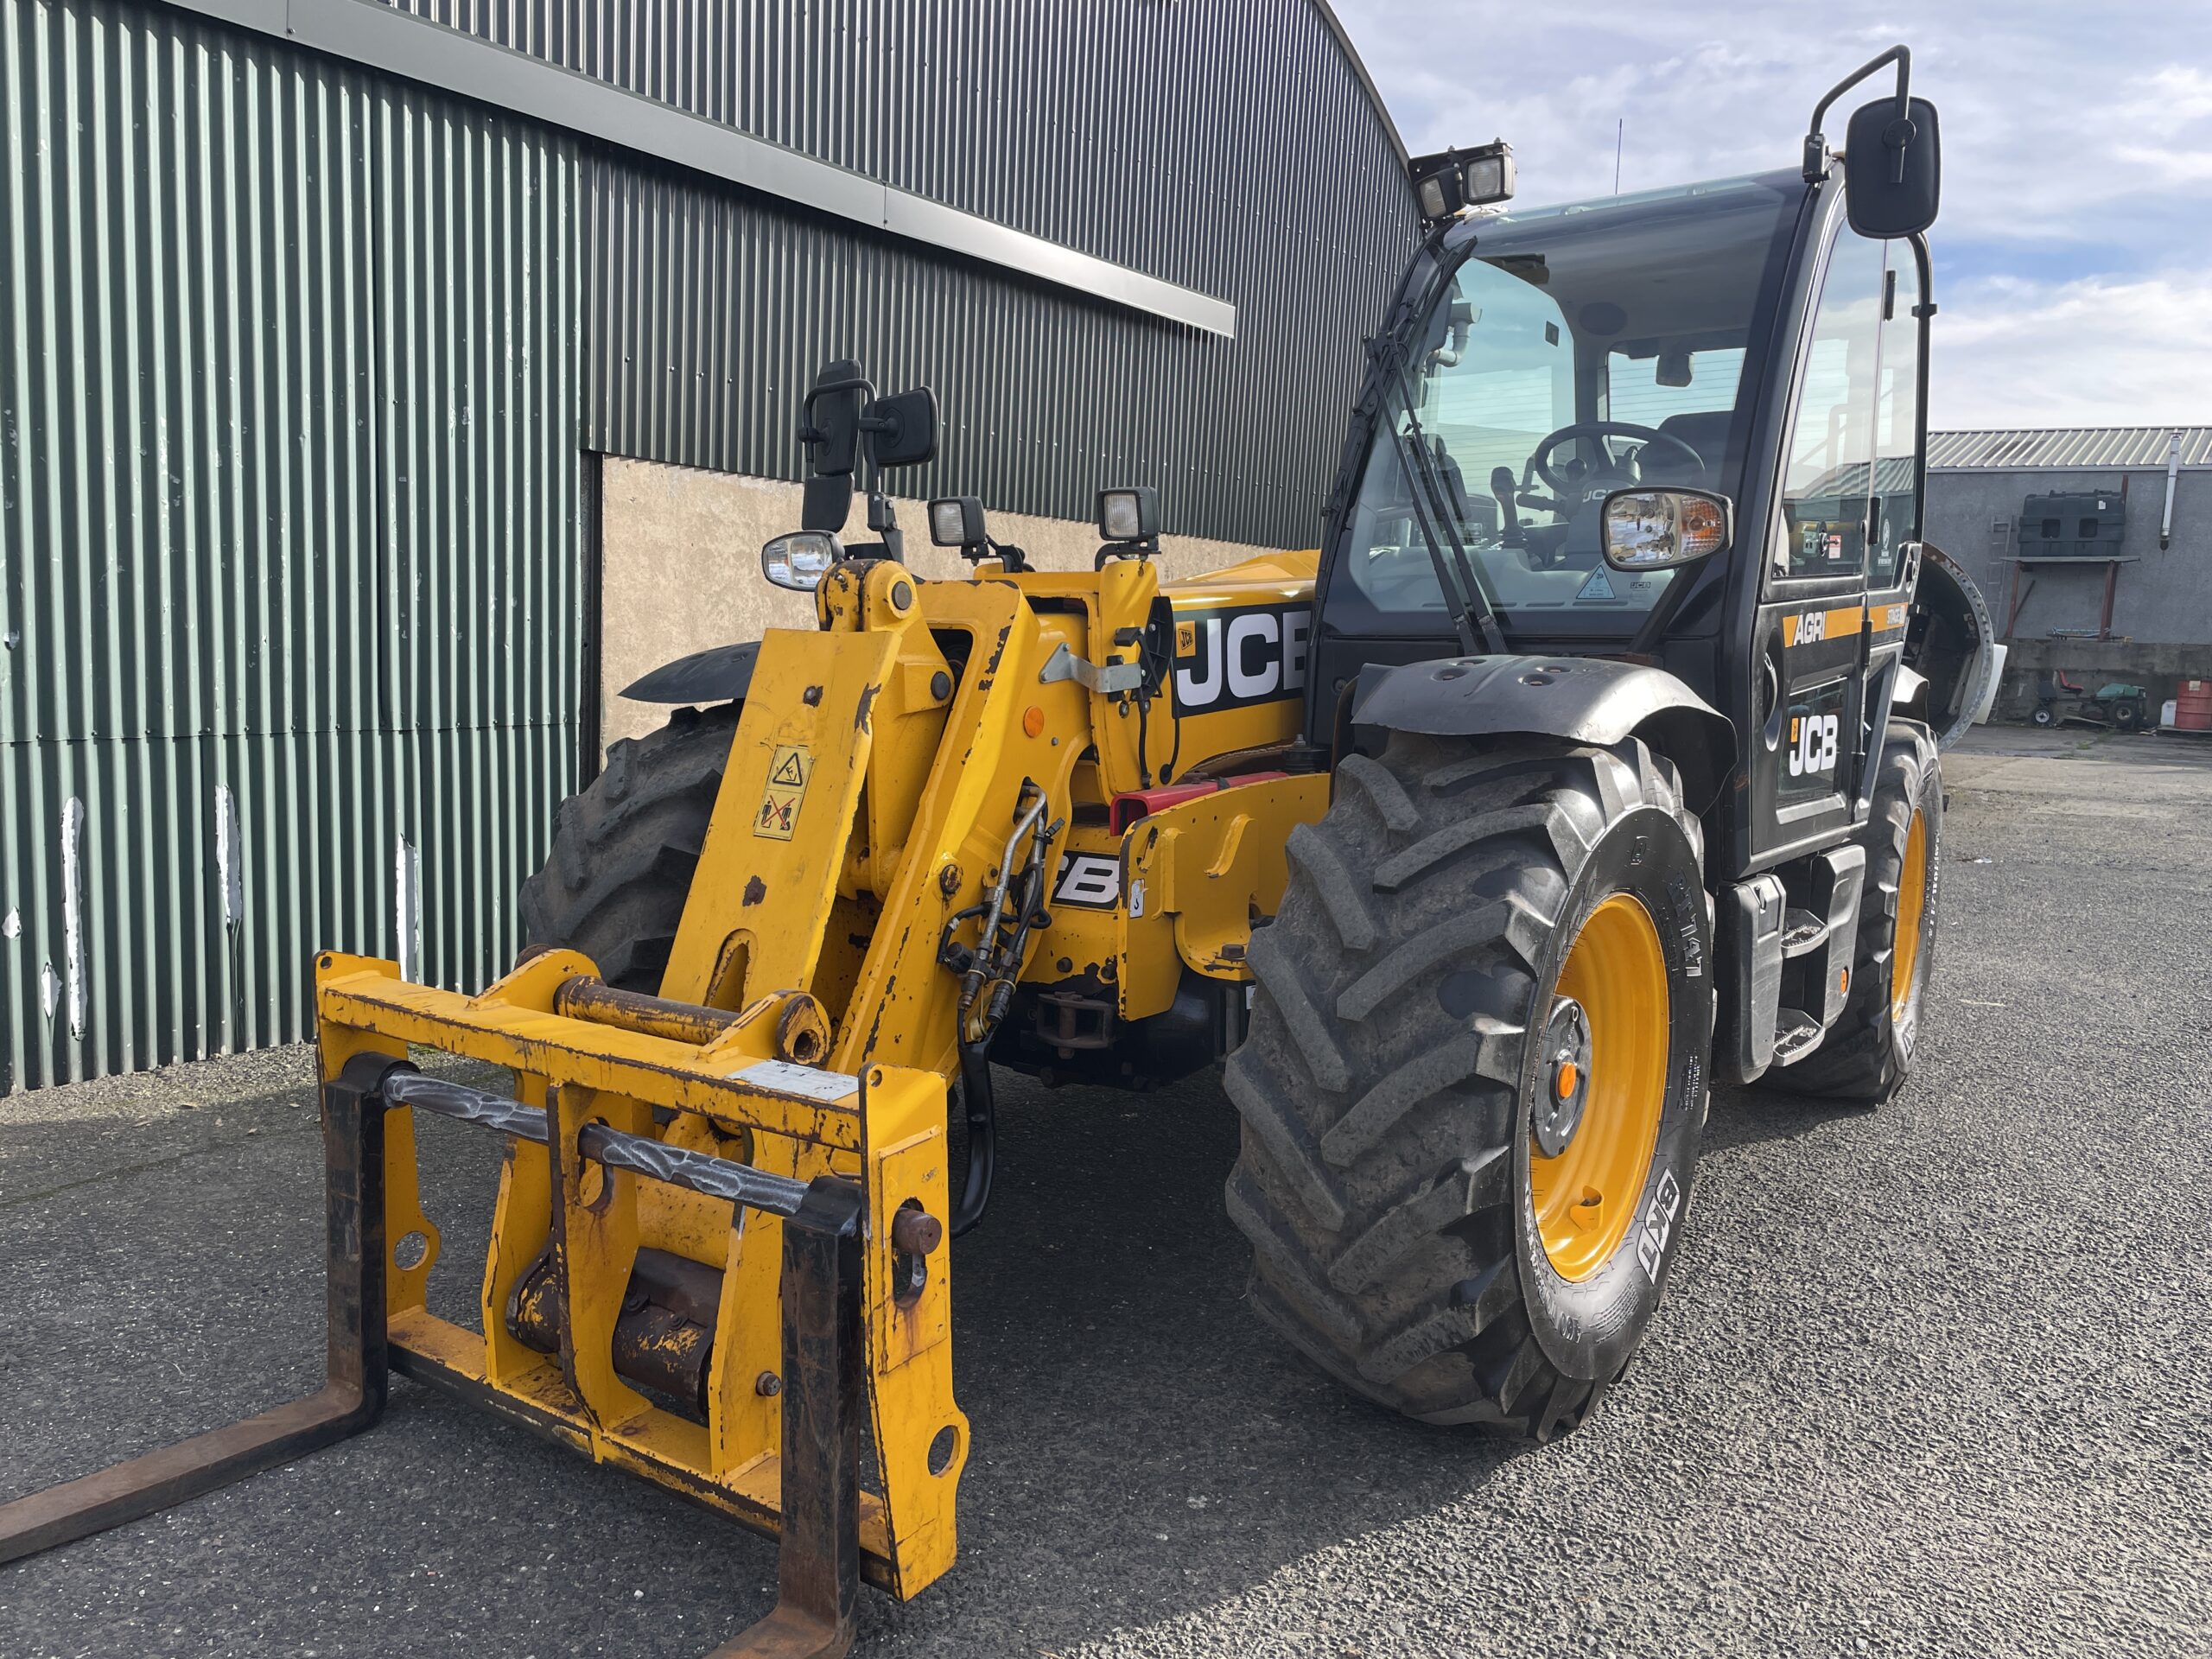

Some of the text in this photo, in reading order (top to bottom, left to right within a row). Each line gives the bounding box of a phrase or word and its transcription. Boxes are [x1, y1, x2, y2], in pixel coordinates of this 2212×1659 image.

[1582, 488, 1614, 503] JC
[1793, 611, 1827, 647] AGRI
[1789, 714, 1838, 777] JCB
[1640, 1173, 1677, 1279] BKT
